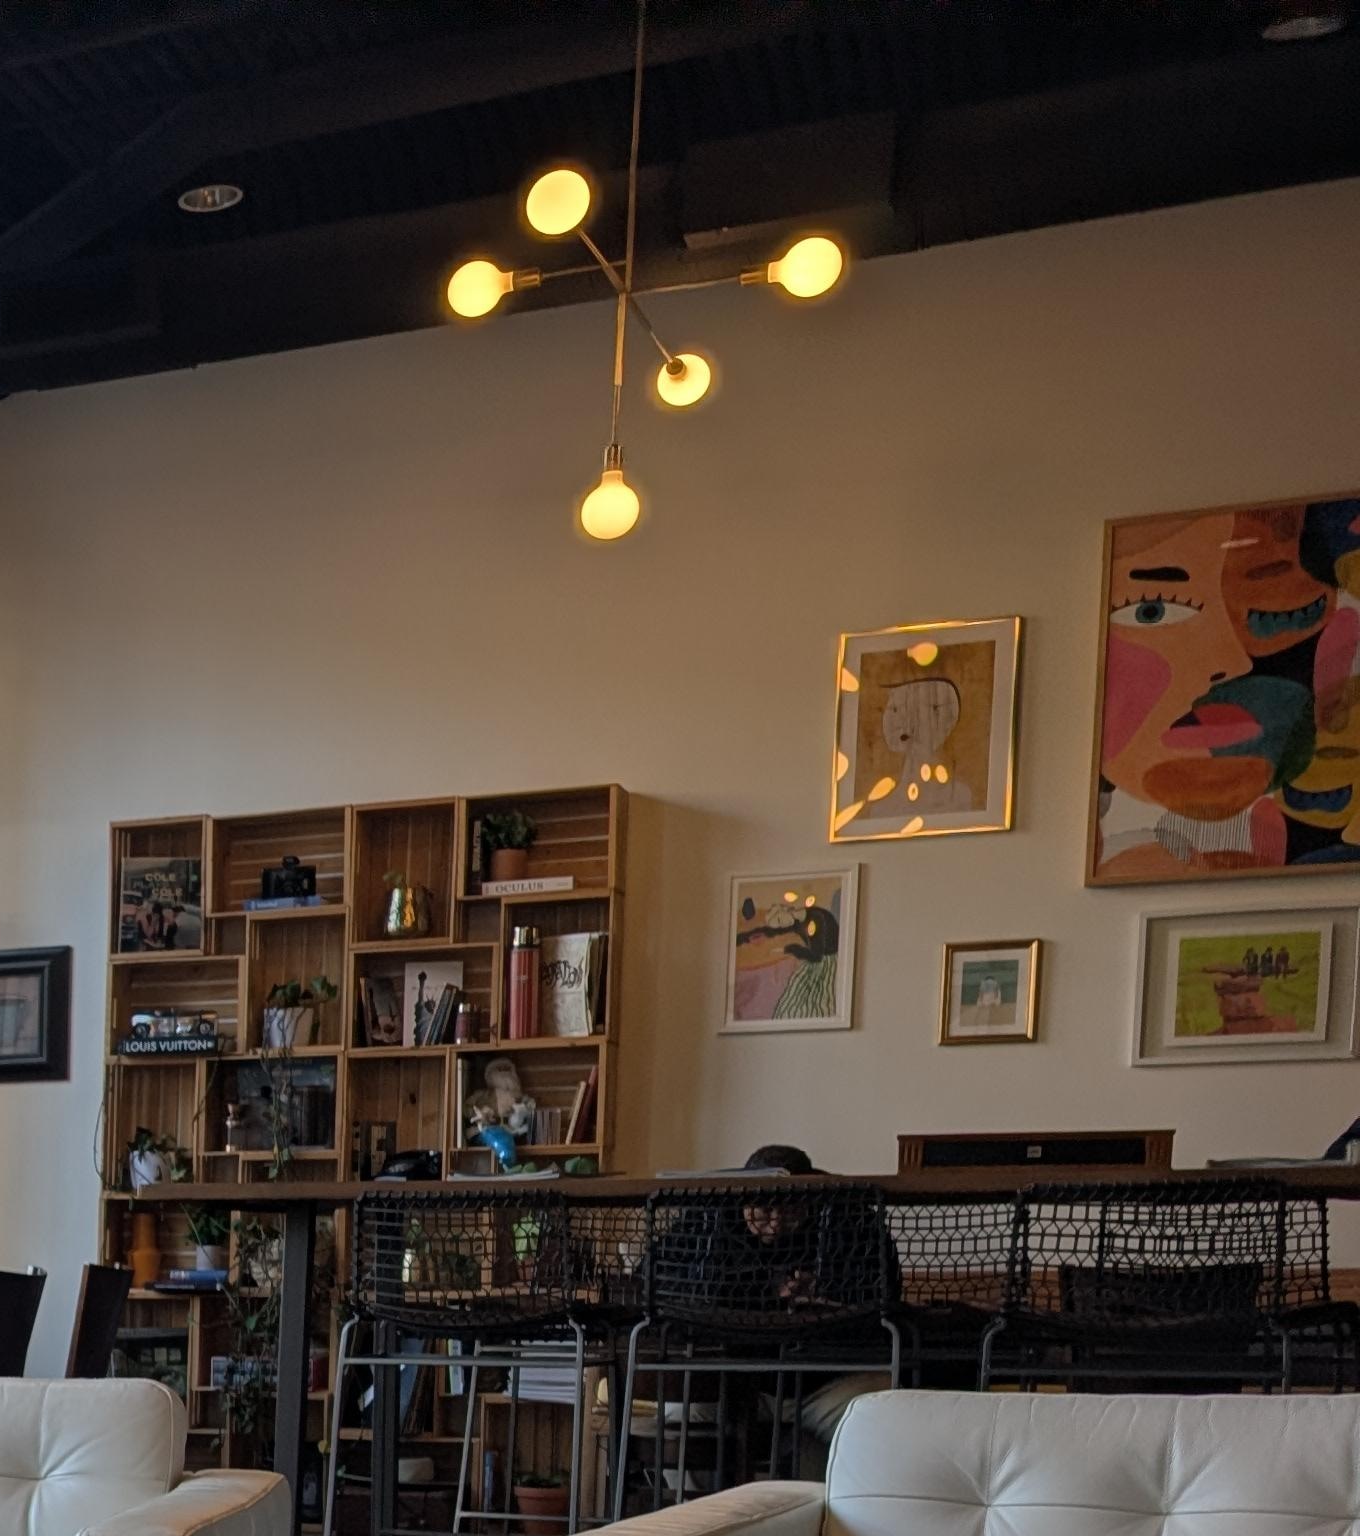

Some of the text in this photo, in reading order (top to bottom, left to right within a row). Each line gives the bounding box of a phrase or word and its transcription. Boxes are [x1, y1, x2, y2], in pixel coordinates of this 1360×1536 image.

[494, 881, 545, 893] OCULUS
[125, 1039, 207, 1052] LOUIS VUITTON
